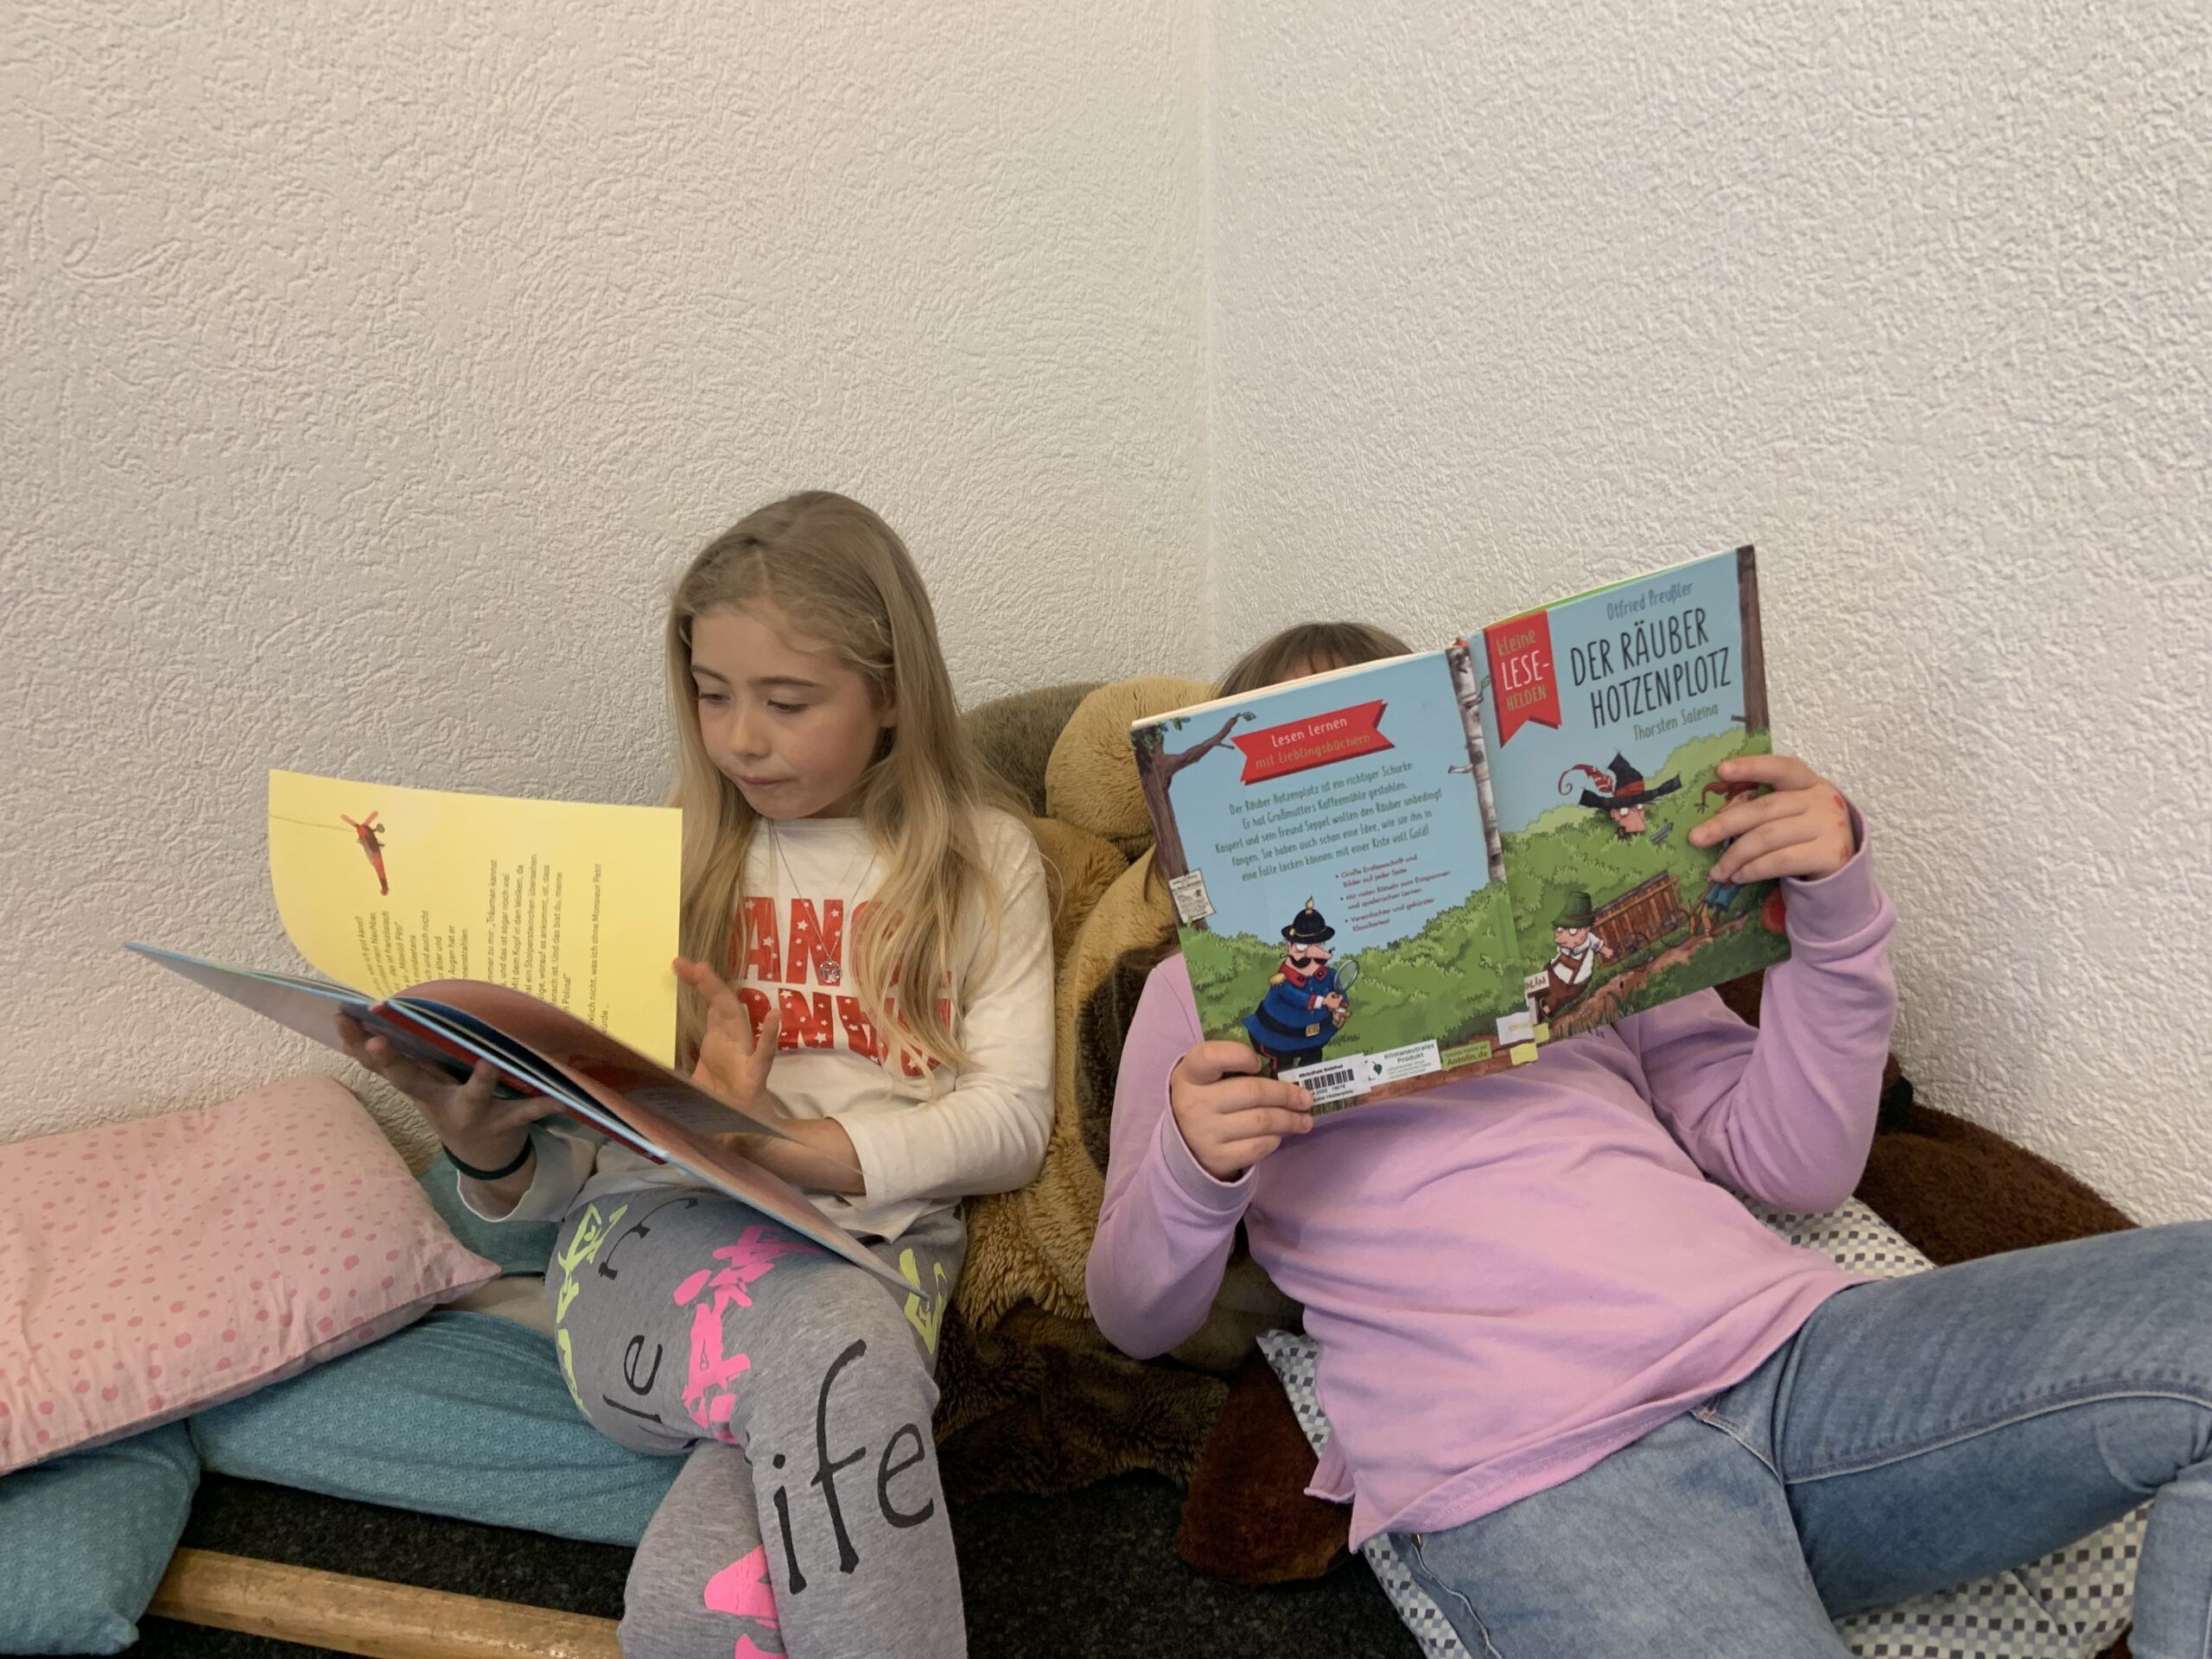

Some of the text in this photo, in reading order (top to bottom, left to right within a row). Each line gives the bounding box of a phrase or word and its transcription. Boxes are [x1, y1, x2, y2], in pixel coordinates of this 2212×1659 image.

[1606, 582, 1693, 621] Otfried Preußler
[1496, 629, 1535, 656] kleine
[1570, 607, 1709, 686] DER RÄUBER
[1501, 651, 1550, 690] LESE-
[1507, 686, 1547, 711] HELDEN
[1591, 647, 1732, 728] HOTZENPLOTZ
[1632, 719, 1678, 741] Thorsten
[1229, 804, 1243, 816] Der
[1244, 798, 1270, 811] Räuber
[1321, 781, 1332, 792] ist
[1332, 780, 1344, 789] ein
[1243, 818, 1250, 830] Er
[1252, 816, 1266, 826] hat
[1267, 804, 1317, 823] Großmutters
[1318, 791, 1366, 810] Kaffeemühle
[1245, 834, 1260, 846] und
[1262, 832, 1277, 842] sein
[1278, 823, 1303, 837] Freund
[1305, 816, 1331, 831] Seppel
[1332, 811, 1358, 824] wollen
[1360, 808, 1375, 817] den
[1376, 801, 1401, 812] Räuber
[1403, 788, 1442, 806] unbedingt
[1261, 849, 1273, 859] Sie
[1274, 845, 1297, 856] haben
[1300, 837, 1318, 850] auch
[1319, 833, 1341, 845] schon
[1343, 829, 1358, 839] eine
[1381, 819, 1395, 830] wie
[1397, 816, 1408, 825] sie
[1410, 812, 1423, 822] ihn
[1242, 872, 1257, 881] eine
[1279, 860, 1304, 872] locken
[1336, 847, 1350, 857] mit
[1351, 843, 1370, 854] einer
[1372, 837, 1390, 848] Kiste
[1393, 831, 1408, 843] voll
[516, 865, 524, 874] da
[1391, 903, 1405, 912] und
[434, 937, 442, 951] und
[487, 946, 493, 956] zu
[513, 937, 522, 956] Kopf
[422, 954, 430, 967] und
[448, 950, 457, 975] Augen
[1384, 1044, 1434, 1059] Klimaneutrales
[1397, 1052, 1424, 1063] Produkt
